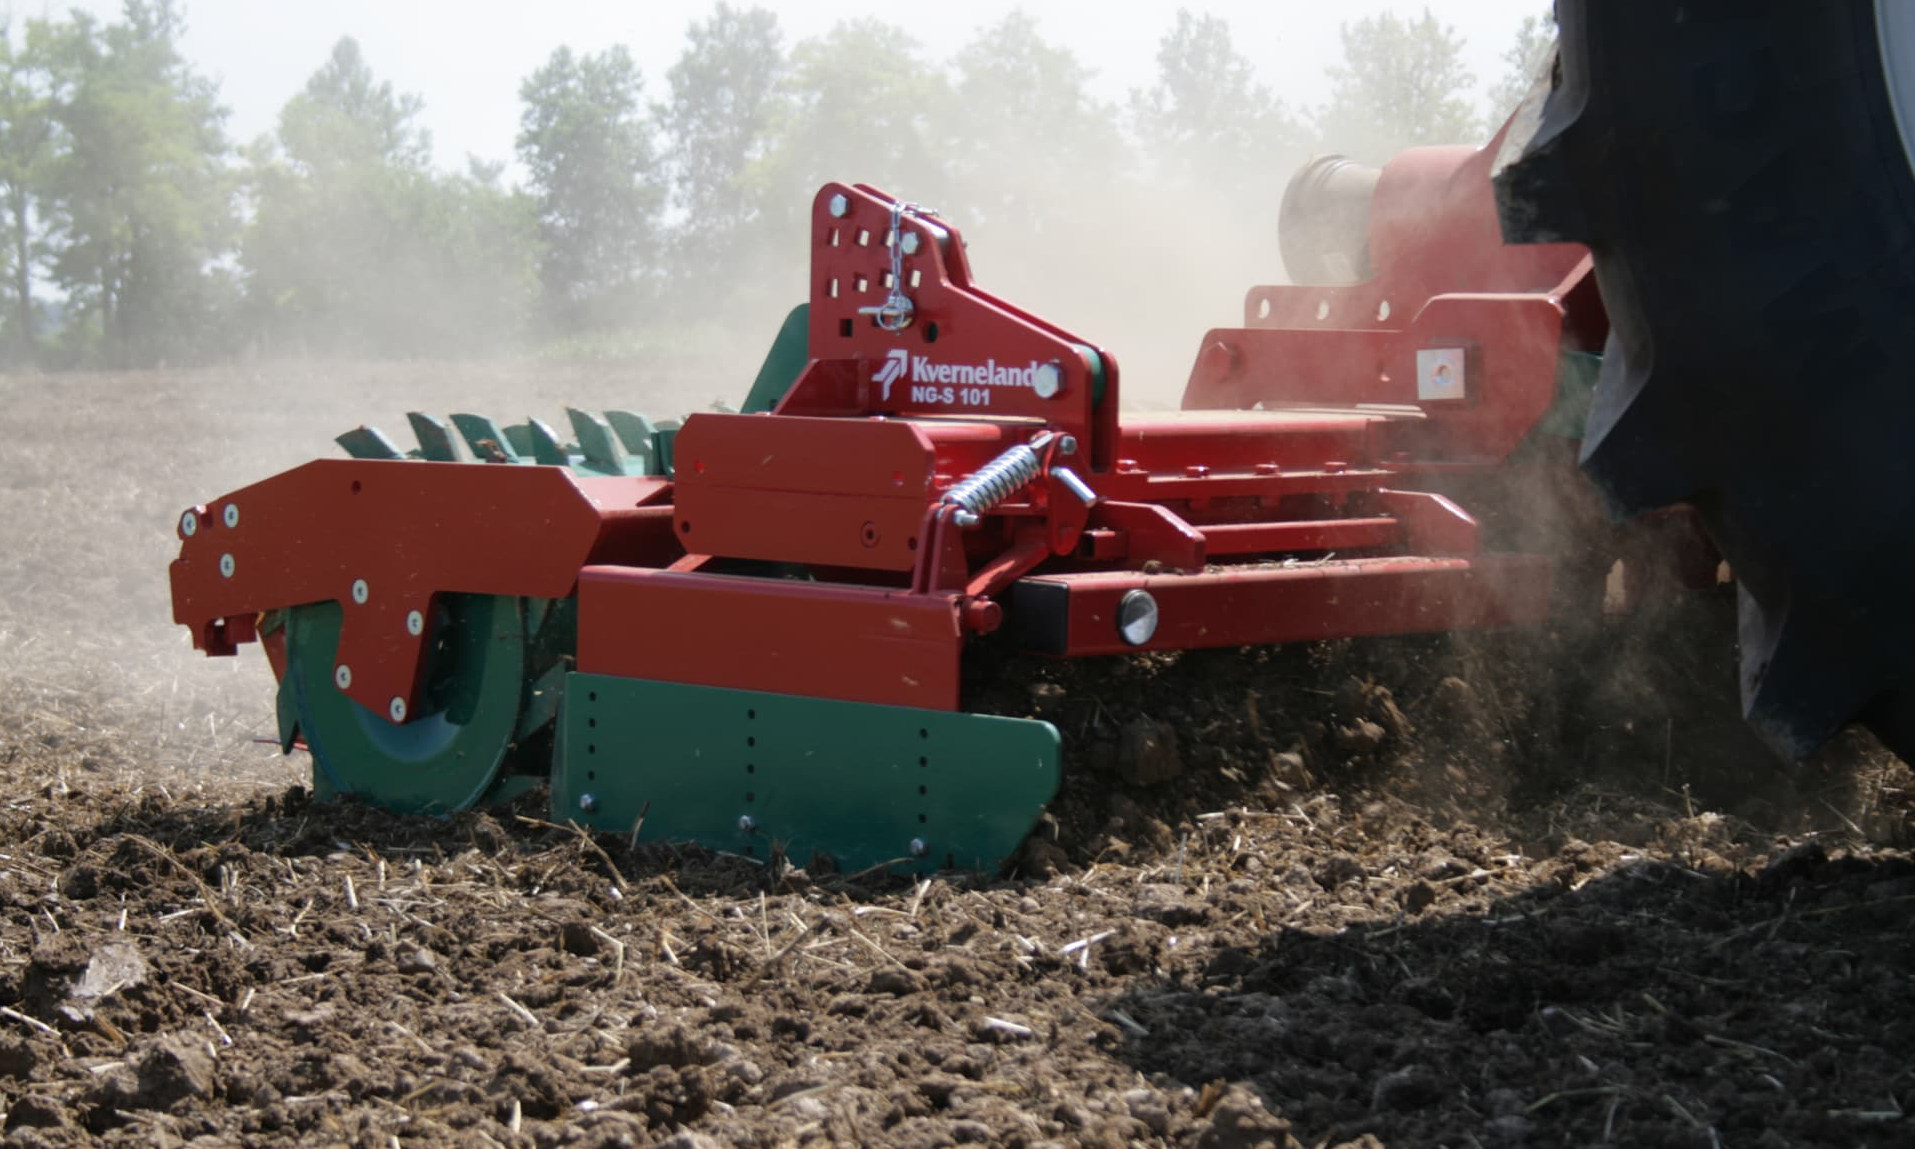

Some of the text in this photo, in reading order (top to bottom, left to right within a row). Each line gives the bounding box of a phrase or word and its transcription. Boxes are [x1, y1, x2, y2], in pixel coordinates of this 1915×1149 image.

[912, 356, 1038, 388] Kverneland
[911, 387, 990, 406] NG-S 101
